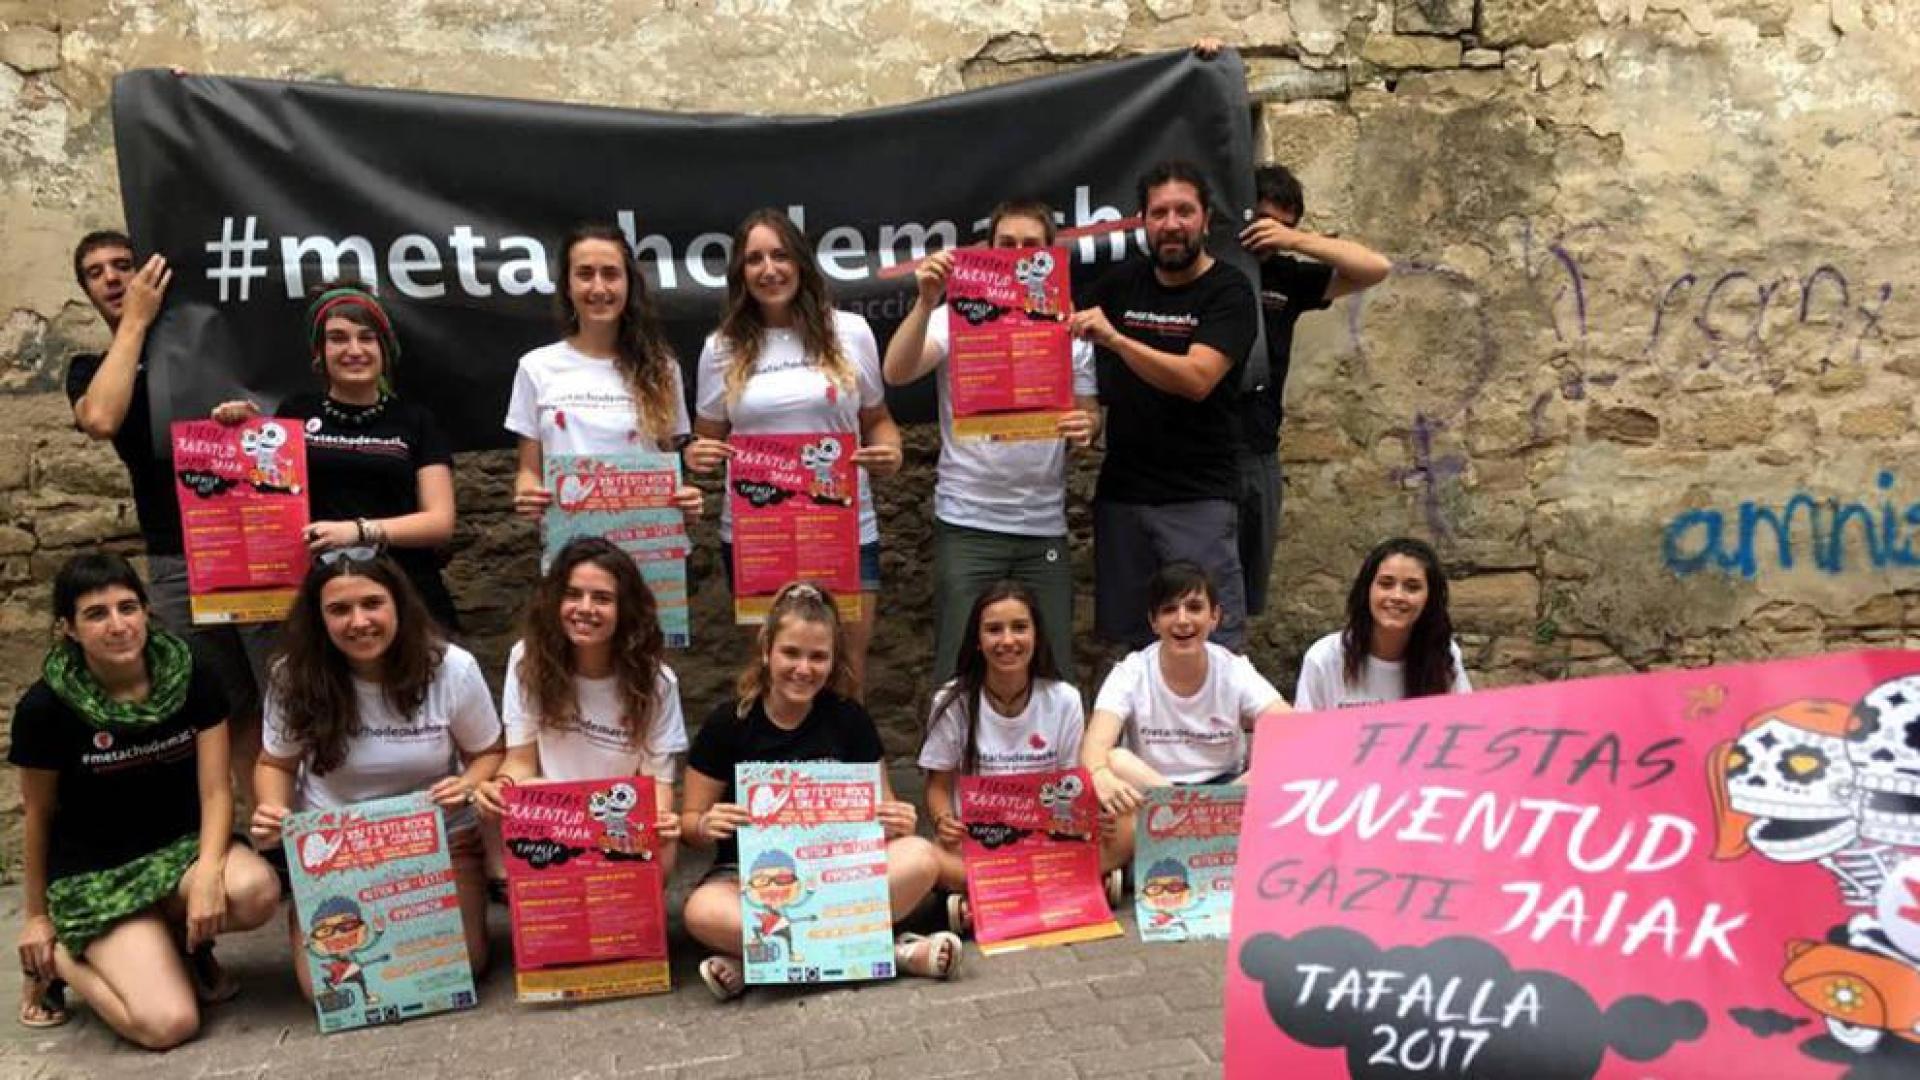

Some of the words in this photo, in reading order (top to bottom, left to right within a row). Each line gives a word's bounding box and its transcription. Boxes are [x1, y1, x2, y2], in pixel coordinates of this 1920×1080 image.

[1353, 720, 1685, 790] FIESTAS
[1269, 778, 1698, 872] JUVENTUD
[1495, 881, 1749, 965] JAIAK
[1295, 962, 1542, 1028] TAFALLA
[1369, 1024, 1490, 1072] 2017
